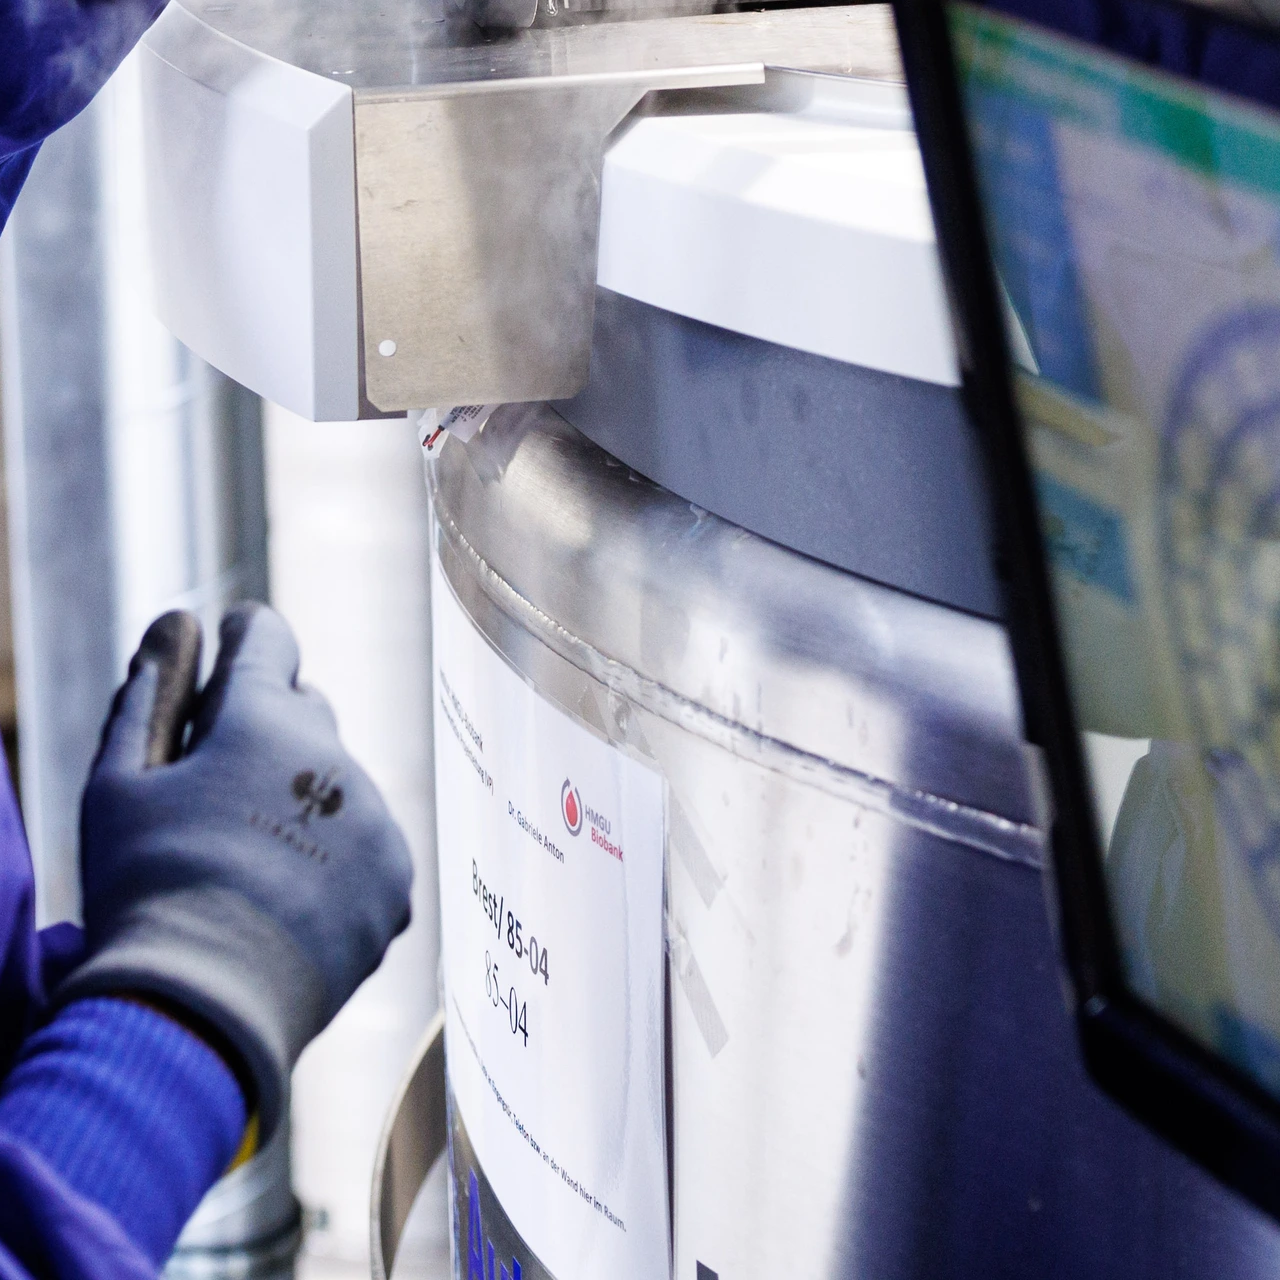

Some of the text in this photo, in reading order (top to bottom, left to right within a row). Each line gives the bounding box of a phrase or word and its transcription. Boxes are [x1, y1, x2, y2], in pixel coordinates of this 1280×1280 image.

[508, 800, 565, 864] Dr. Gabriele Anton
[585, 804, 611, 835] HMGU
[591, 827, 624, 863] Biobank
[472, 857, 550, 986] Brest/ 85-04
[485, 950, 529, 1047] 85-04
[550, 1158, 560, 1174] der
[561, 1167, 578, 1192] Wand
[580, 1183, 592, 1204] hier
[594, 1196, 602, 1213] im
[604, 1205, 627, 1232] Raum.
